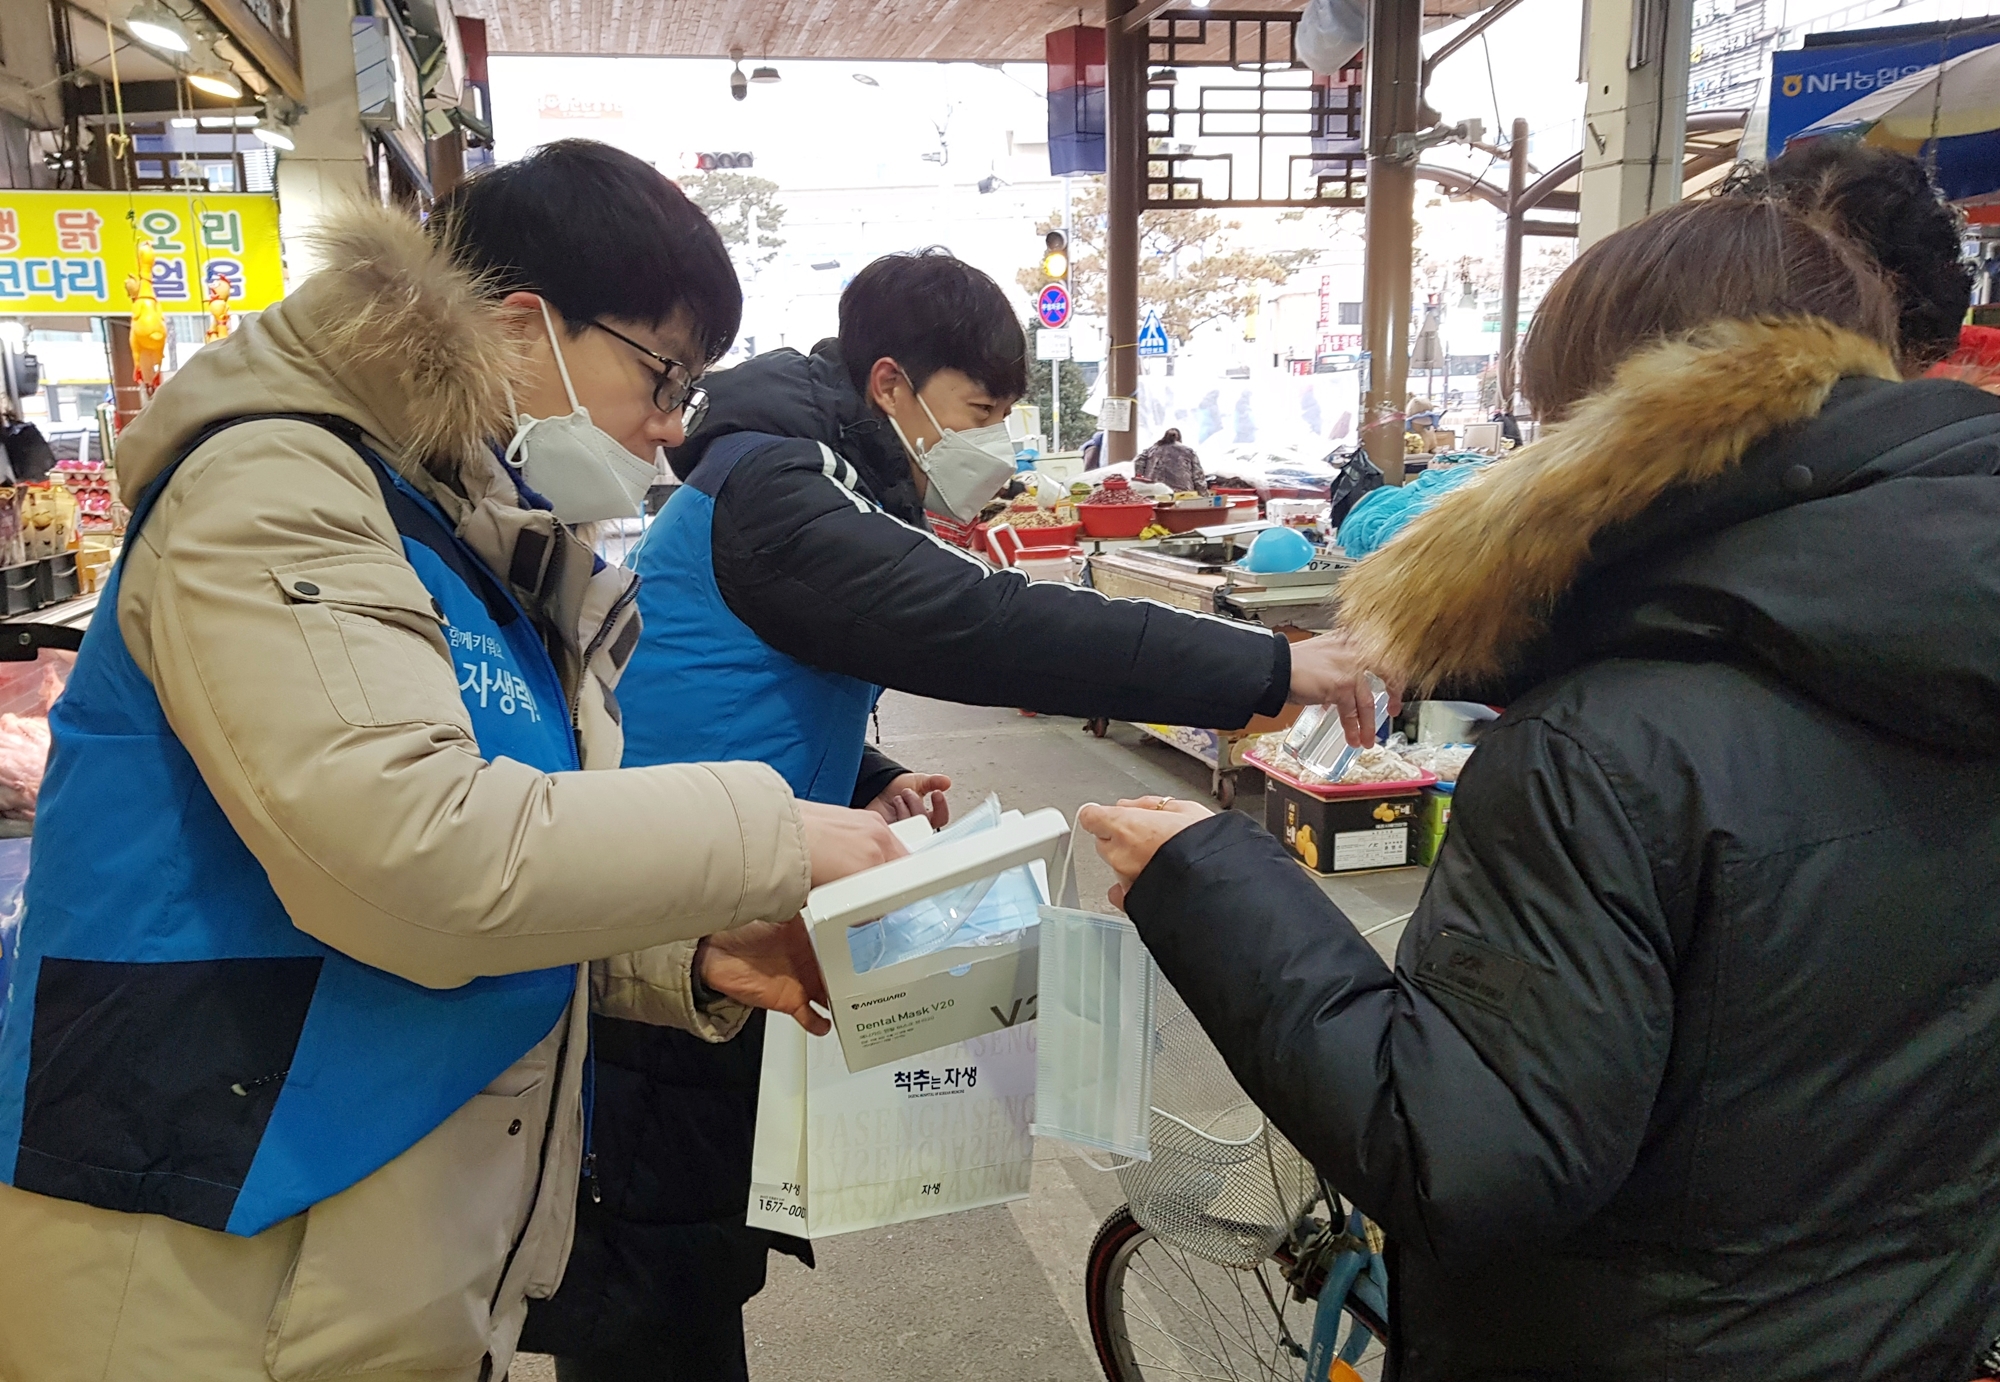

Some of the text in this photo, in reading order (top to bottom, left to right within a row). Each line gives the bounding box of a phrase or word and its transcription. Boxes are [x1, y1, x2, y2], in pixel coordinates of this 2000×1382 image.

[859, 992, 907, 1008] ANYGUARD
[856, 998, 955, 1032] Dental Mask V20
[894, 1066, 978, 1093] 척추는 자생
[781, 1181, 941, 1196] 자생 자생
